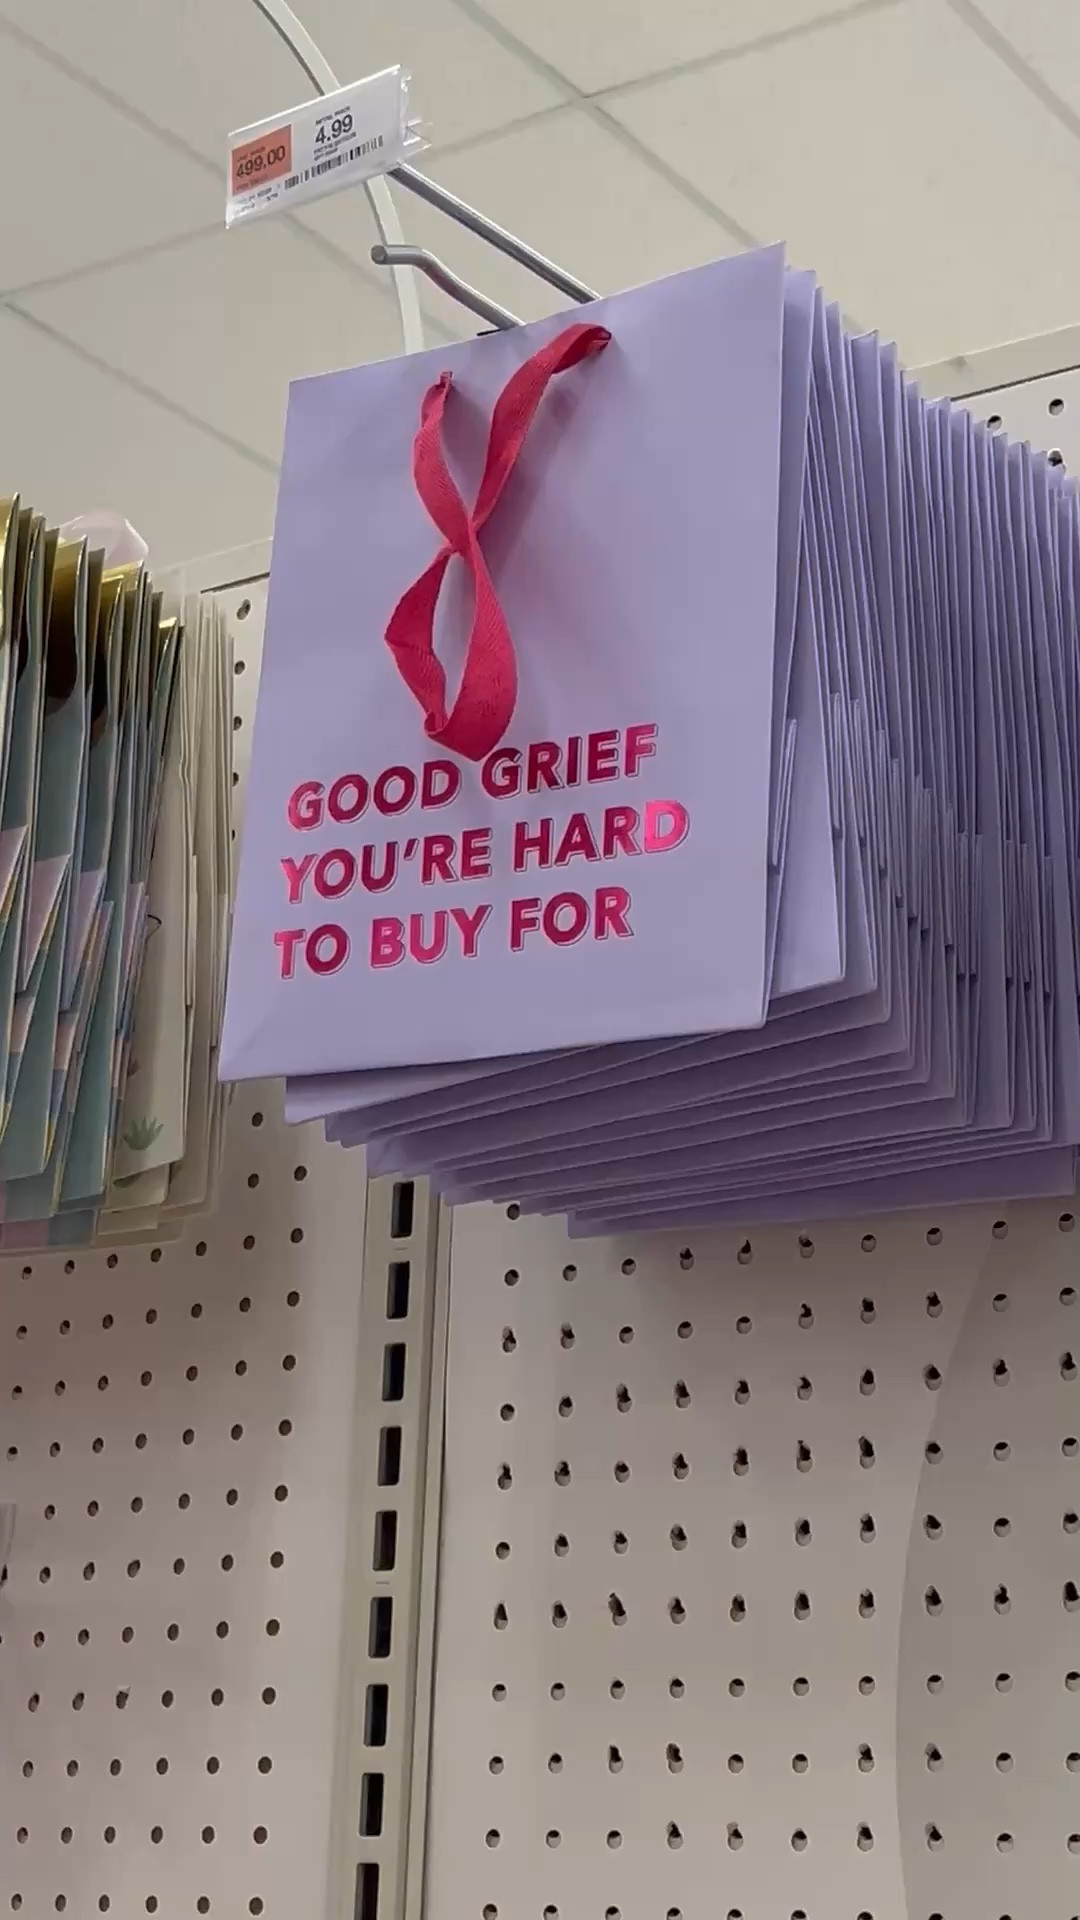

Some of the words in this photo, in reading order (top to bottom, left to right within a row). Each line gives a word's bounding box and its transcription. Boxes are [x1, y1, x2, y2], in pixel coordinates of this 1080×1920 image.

[236, 145, 286, 178] 499.00
[315, 114, 353, 144] 4.99
[288, 759, 461, 832] GOOD
[481, 723, 659, 799] GRIEF
[280, 827, 493, 904] YOU'RE
[513, 800, 691, 872] HARD
[273, 922, 350, 979] TO
[370, 904, 492, 969] BUY
[510, 886, 634, 952] FOR
